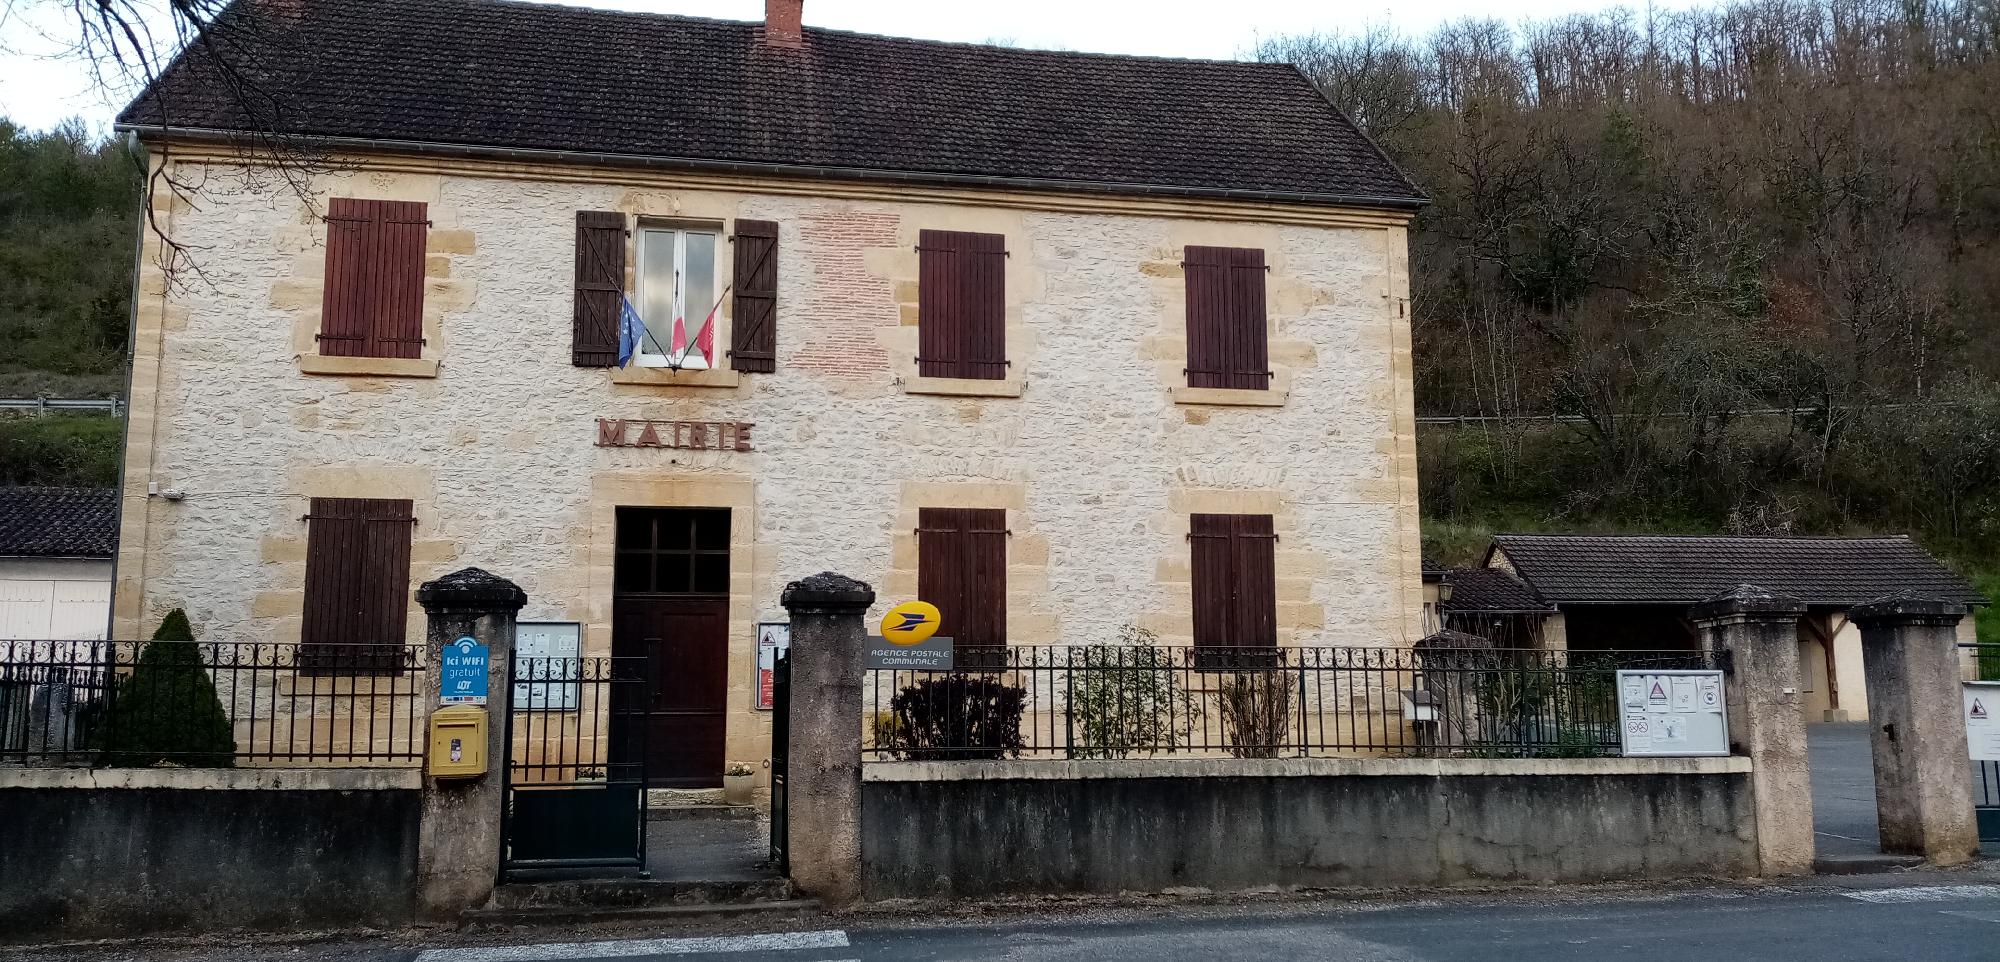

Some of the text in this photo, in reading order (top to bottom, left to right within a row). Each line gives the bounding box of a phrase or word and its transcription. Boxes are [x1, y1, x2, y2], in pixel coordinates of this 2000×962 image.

[599, 418, 751, 451] MAIRIE
[871, 649, 950, 658] AGENCE POSTALE
[449, 667, 481, 679] gratuit
